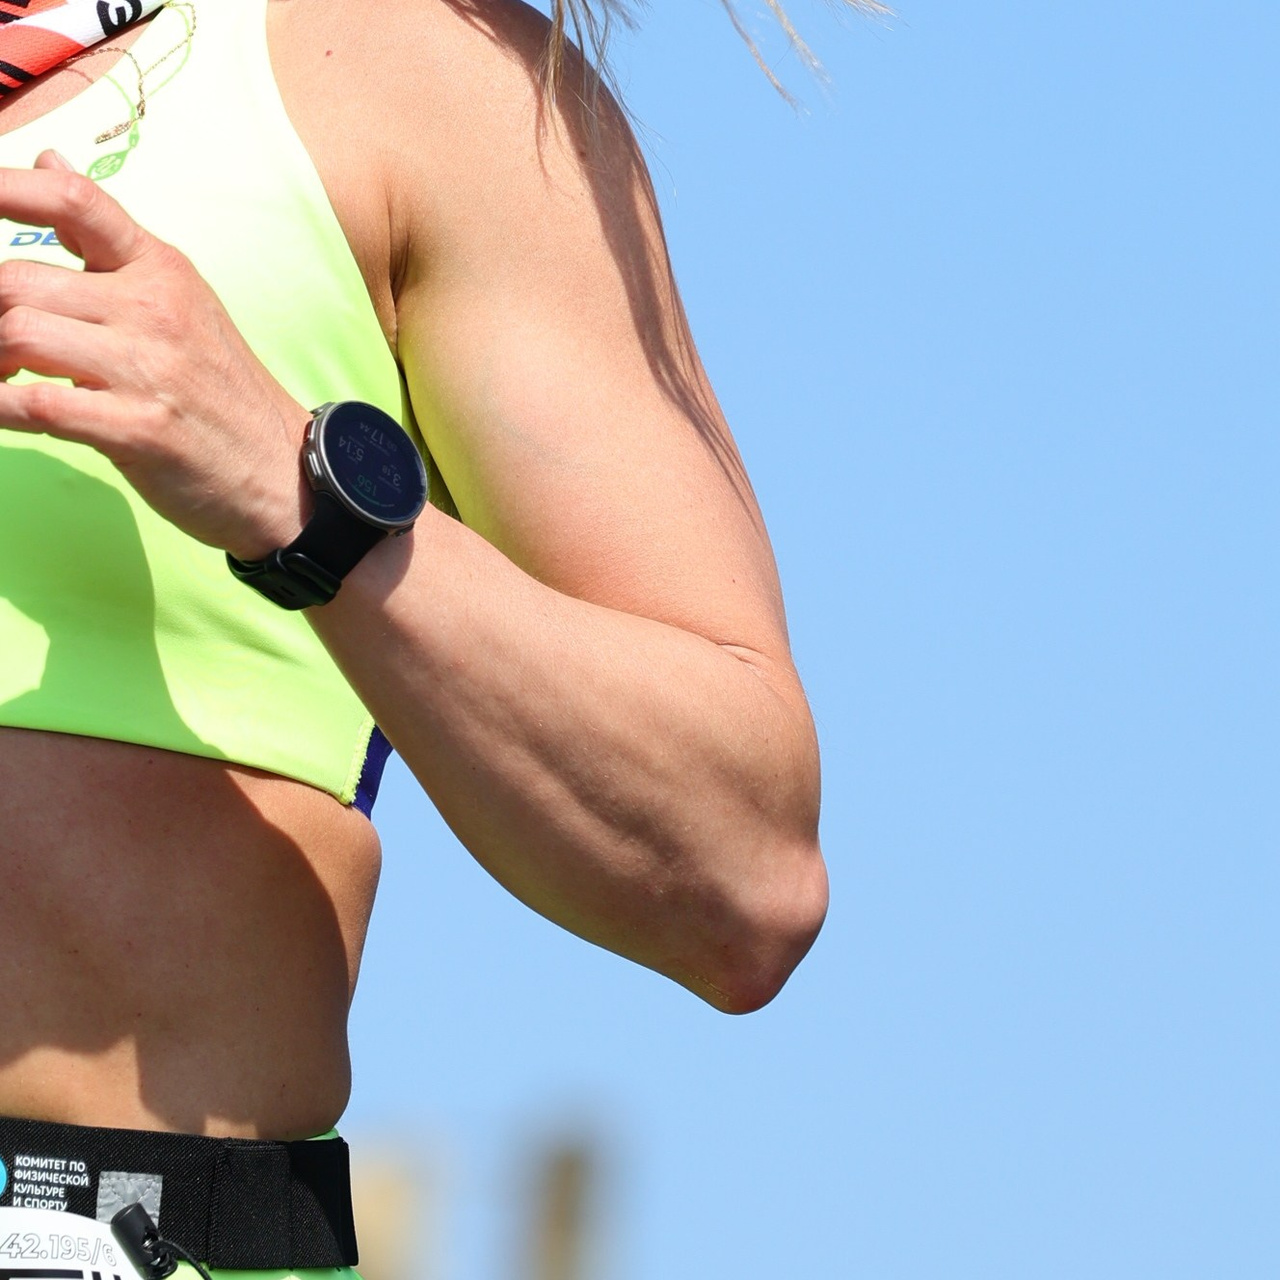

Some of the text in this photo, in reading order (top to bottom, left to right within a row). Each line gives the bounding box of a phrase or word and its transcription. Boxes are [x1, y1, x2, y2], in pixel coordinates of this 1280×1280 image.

[15, 1155, 86, 1173] КОМИТЕТ ПО
[14, 1170, 89, 1187] ФИЗИЧЕСКОЙ
[13, 1182, 65, 1198] КУЛЬТУРЕ
[13, 1195, 68, 1211] И СПОРТУ
